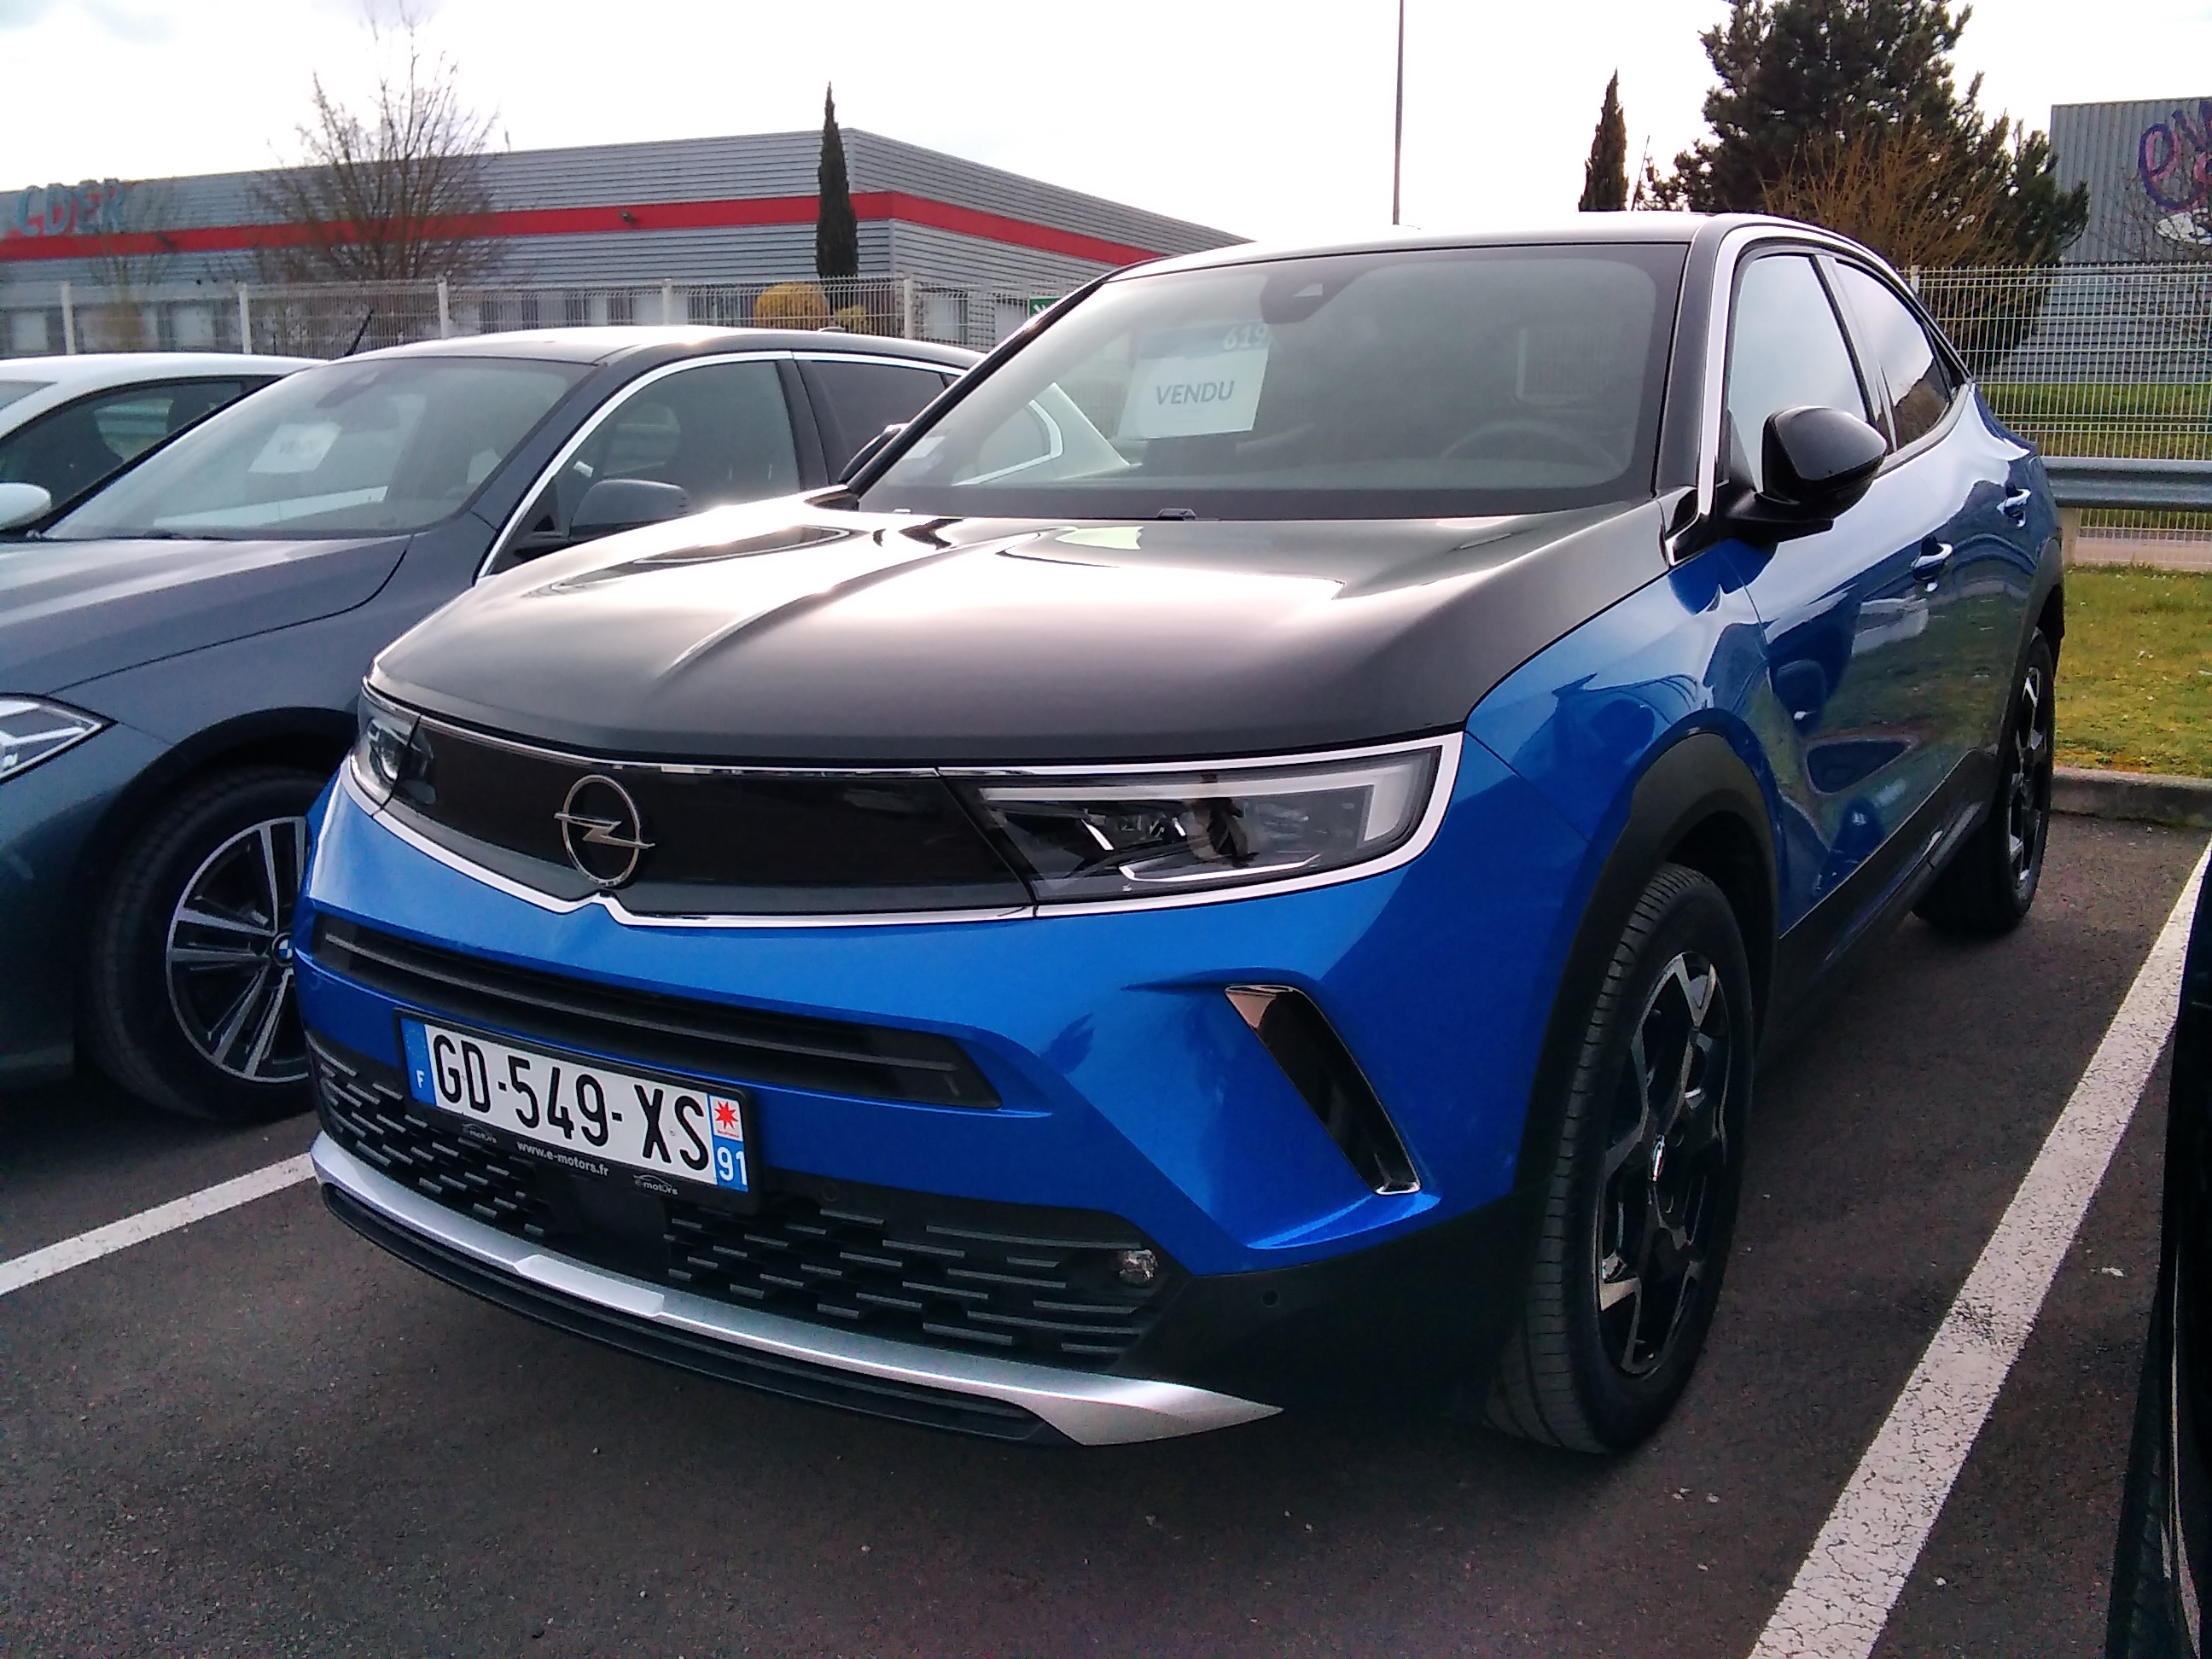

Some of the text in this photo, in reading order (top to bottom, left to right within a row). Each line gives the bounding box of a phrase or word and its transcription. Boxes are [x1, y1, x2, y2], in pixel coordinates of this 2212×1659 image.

[1156, 381, 1235, 405] VENDU
[415, 1069, 425, 1089] F
[433, 1034, 709, 1171] GD-549-XS
[516, 1141, 609, 1177] www.e-motors.fr
[717, 1146, 748, 1186] 91
